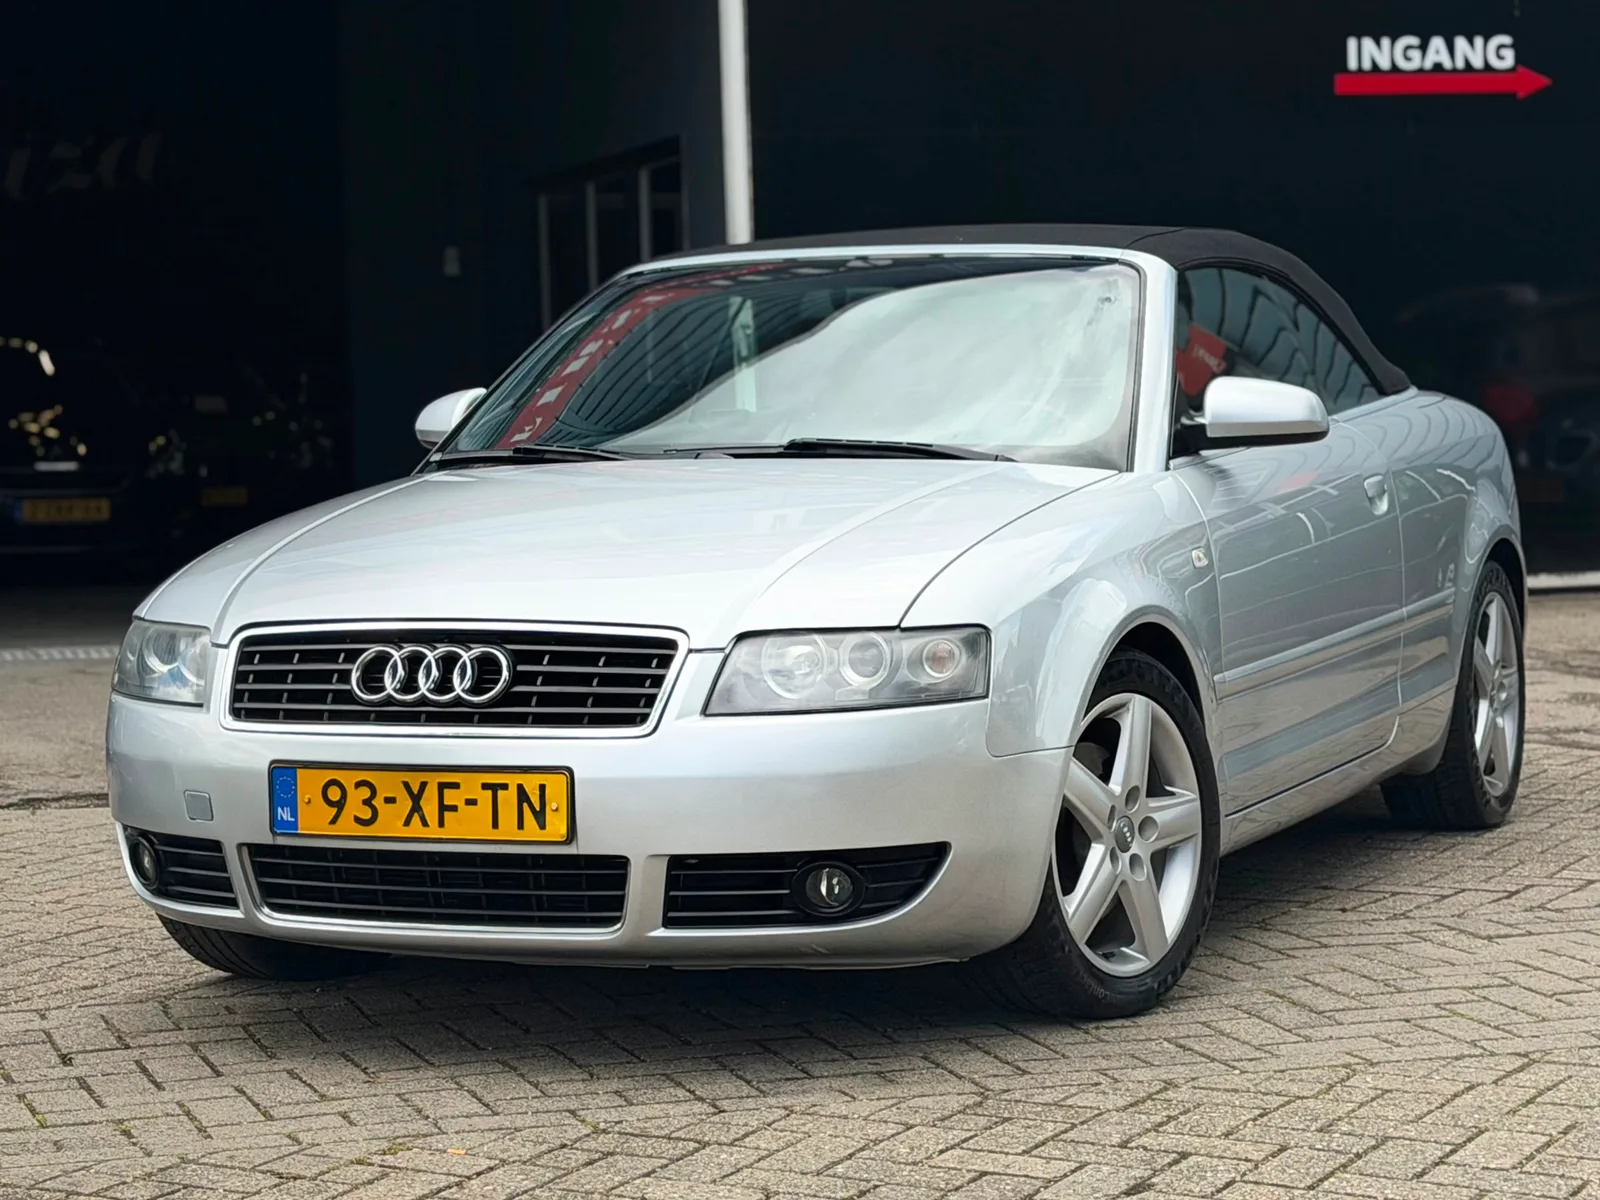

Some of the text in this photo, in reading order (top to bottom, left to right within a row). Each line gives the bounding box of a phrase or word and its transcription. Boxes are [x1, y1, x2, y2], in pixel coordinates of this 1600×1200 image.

[1346, 34, 1516, 71] INGANG
[277, 806, 295, 821] NL
[321, 778, 547, 830] 93-XF-TN
